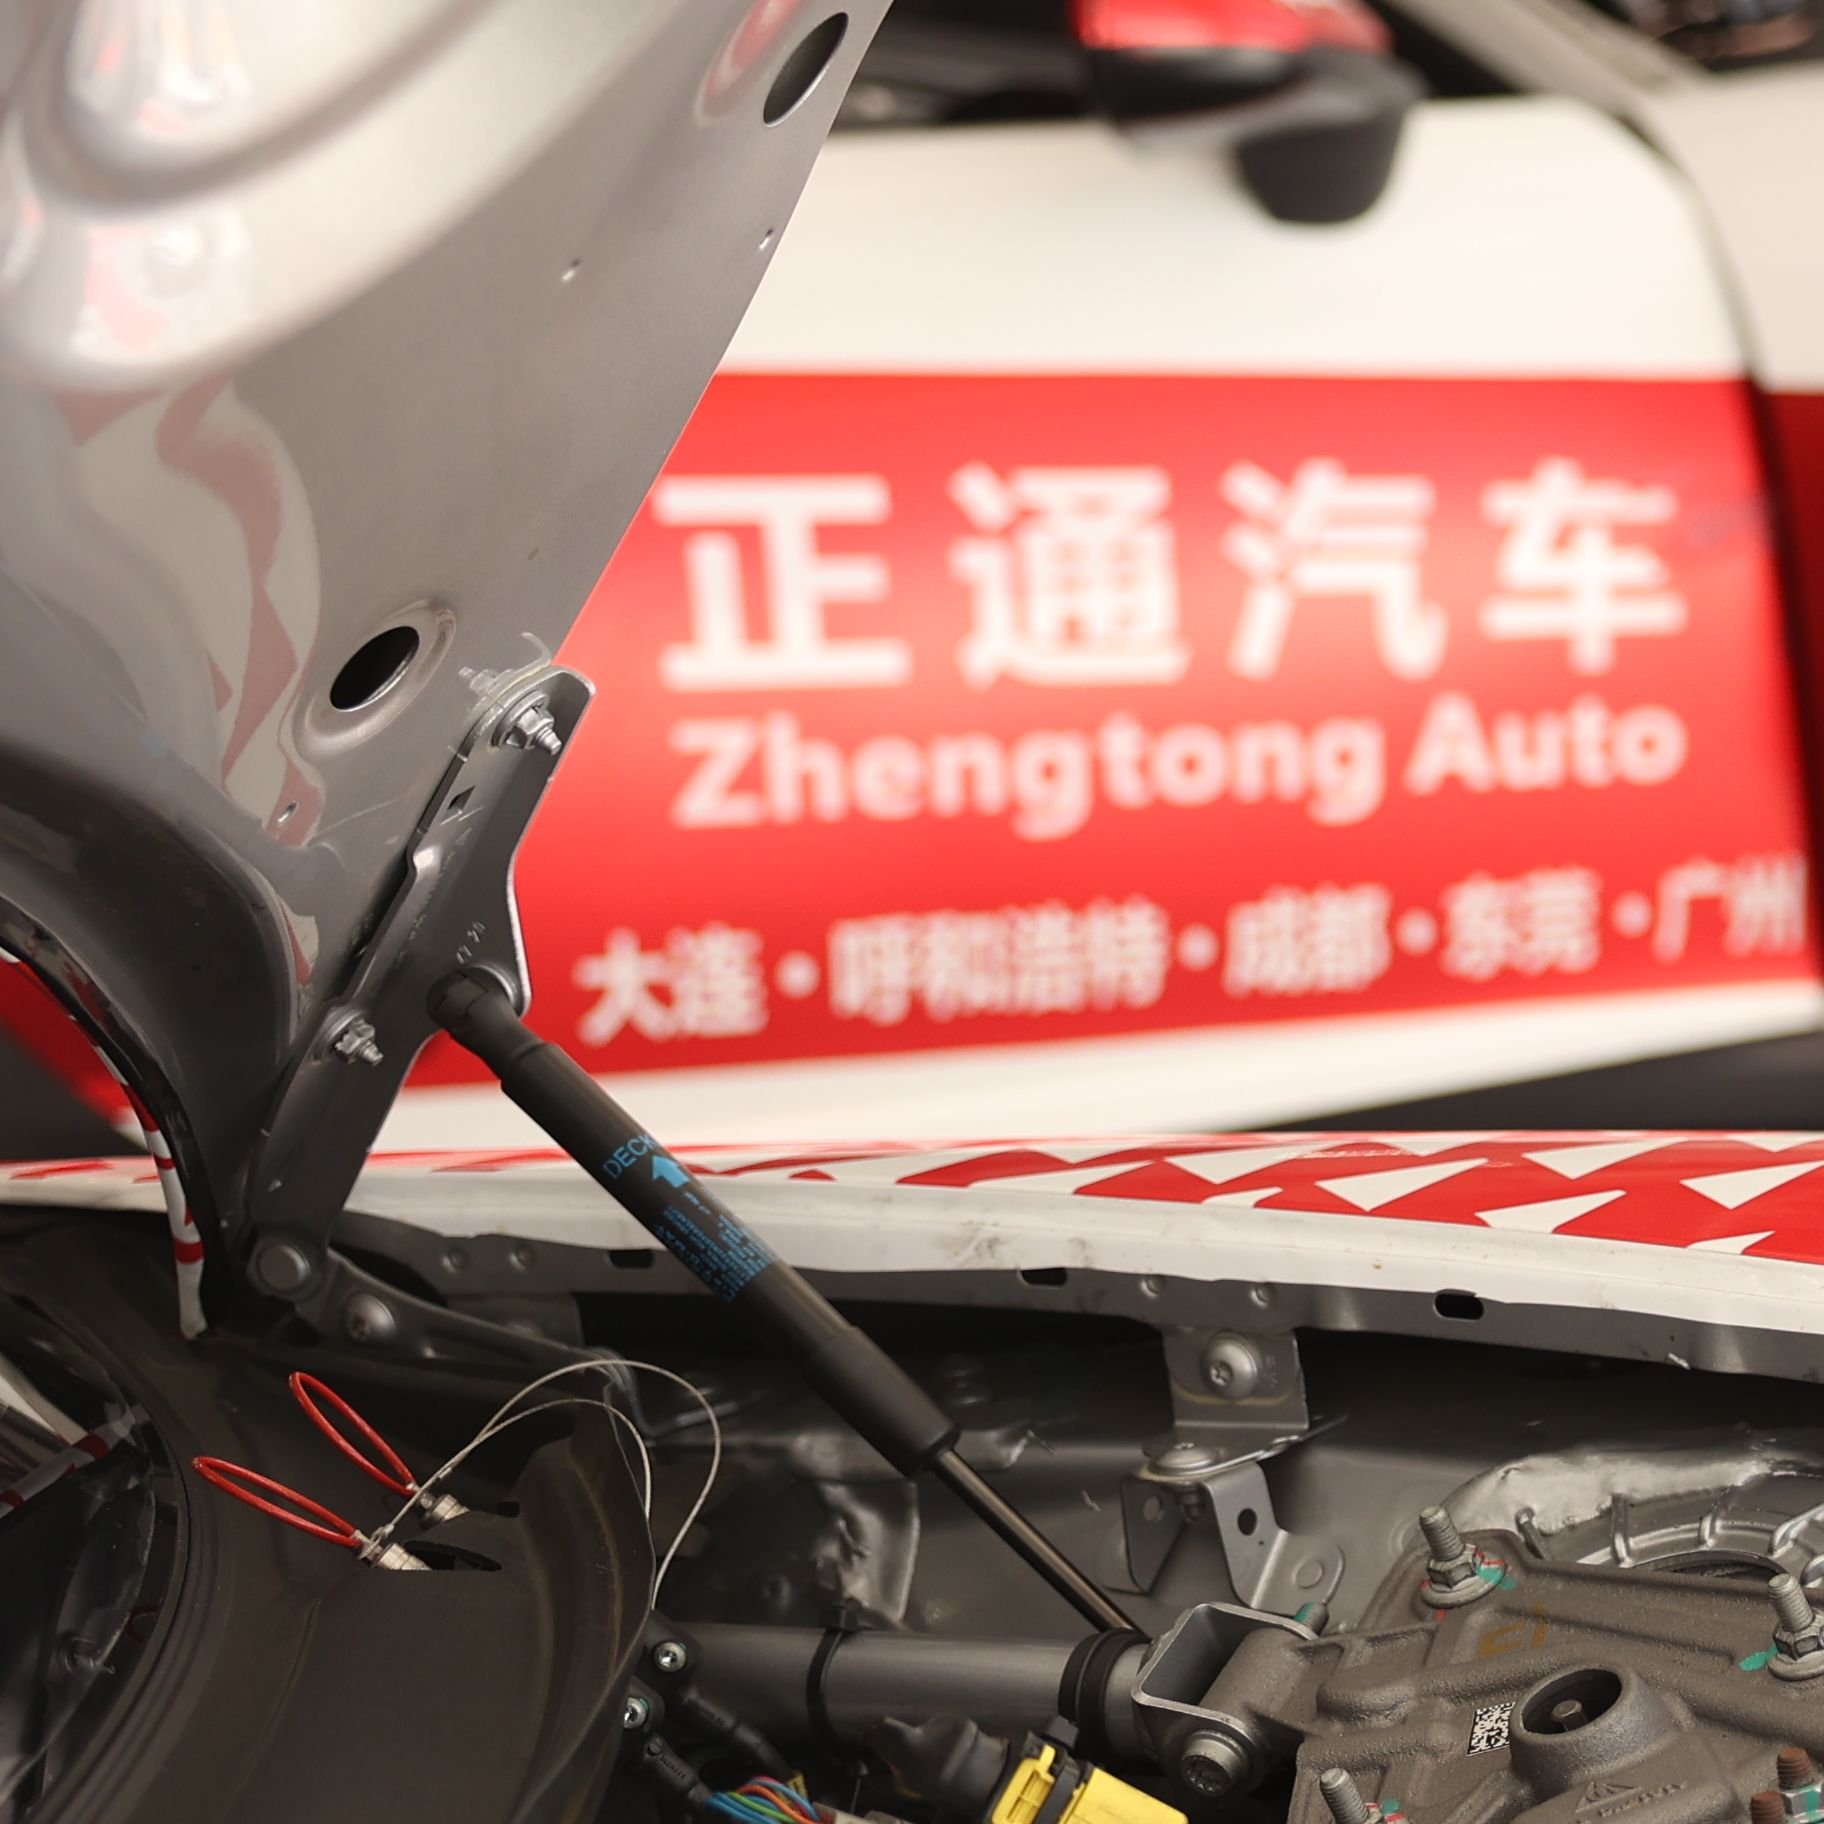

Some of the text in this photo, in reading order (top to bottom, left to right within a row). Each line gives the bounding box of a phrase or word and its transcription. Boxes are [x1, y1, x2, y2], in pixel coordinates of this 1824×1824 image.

[651, 458, 1690, 692] 正通汽车
[669, 690, 1687, 841] Zhengtong Auto
